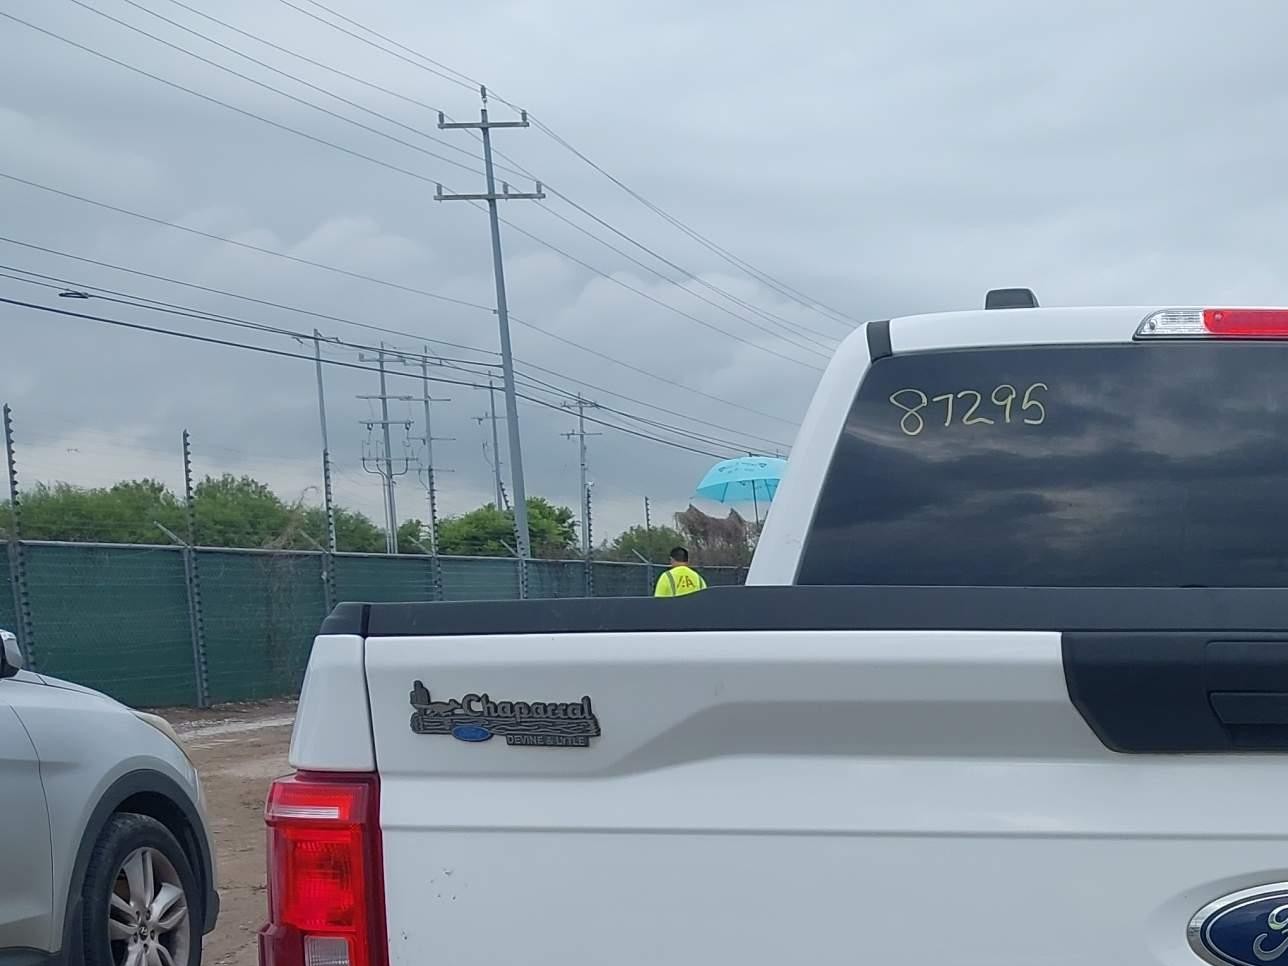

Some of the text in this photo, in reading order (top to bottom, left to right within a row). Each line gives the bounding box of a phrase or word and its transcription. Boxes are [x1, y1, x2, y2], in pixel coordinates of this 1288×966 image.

[889, 382, 1048, 436] 87295
[461, 693, 593, 722] Chaparral
[506, 735, 545, 745] DEVINE
